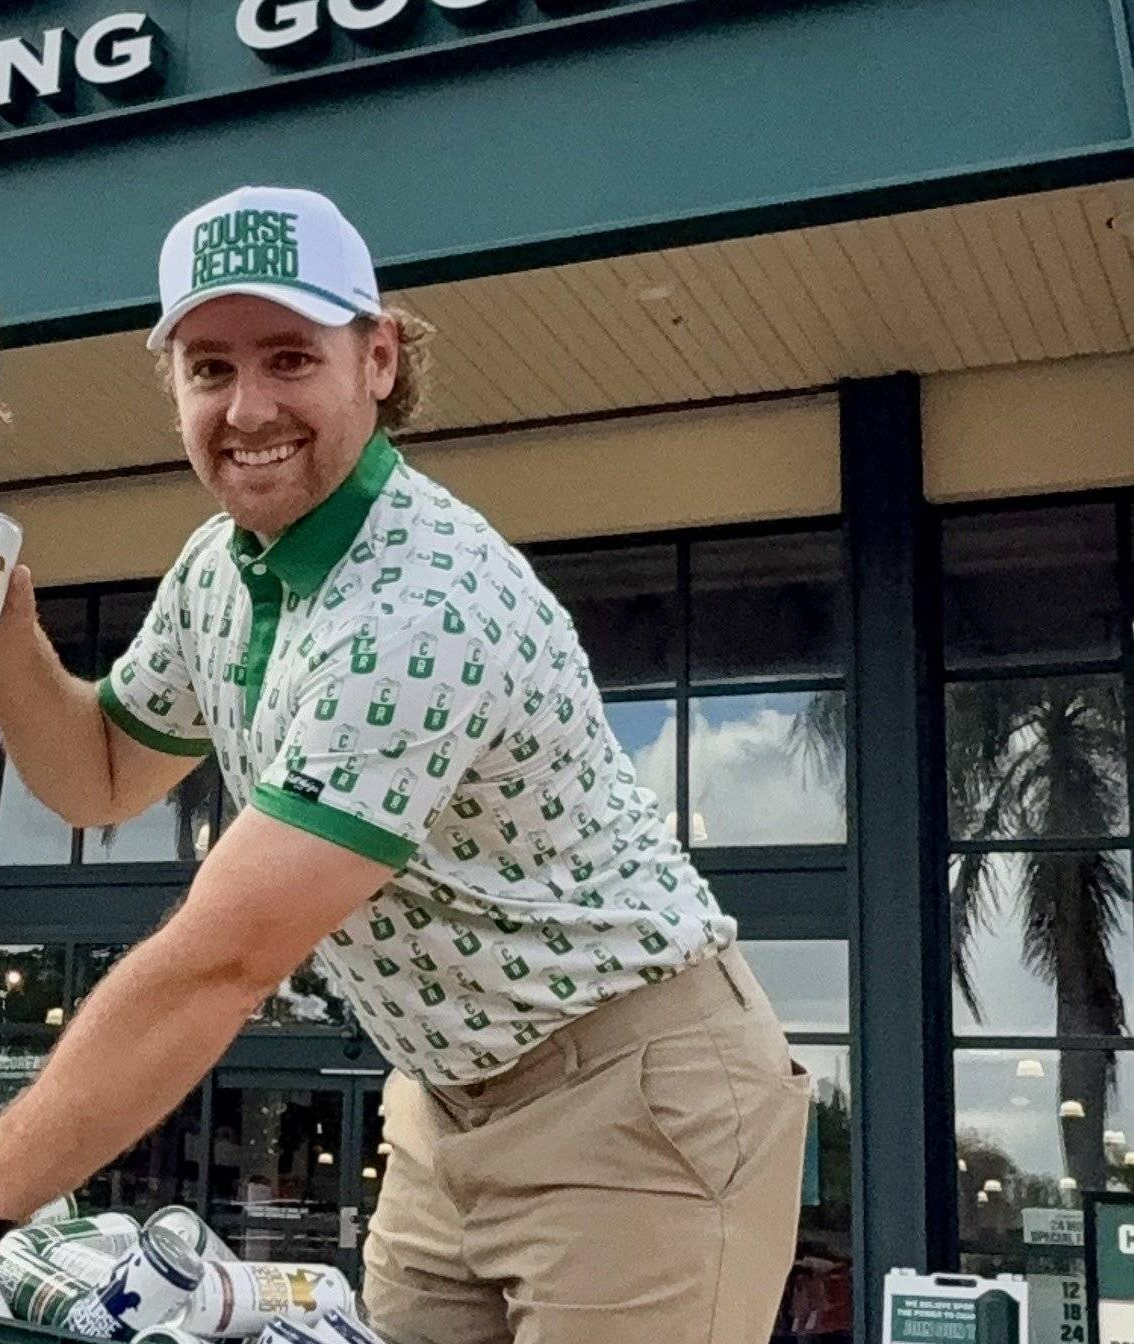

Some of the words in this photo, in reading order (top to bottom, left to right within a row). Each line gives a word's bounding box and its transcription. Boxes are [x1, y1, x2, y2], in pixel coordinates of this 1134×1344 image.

[193, 209, 299, 255] COURSE
[191, 244, 299, 289] RECORD
[1062, 1281, 1081, 1299] 12
[1063, 1303, 1082, 1321] 18
[1060, 1324, 1084, 1343] 24
